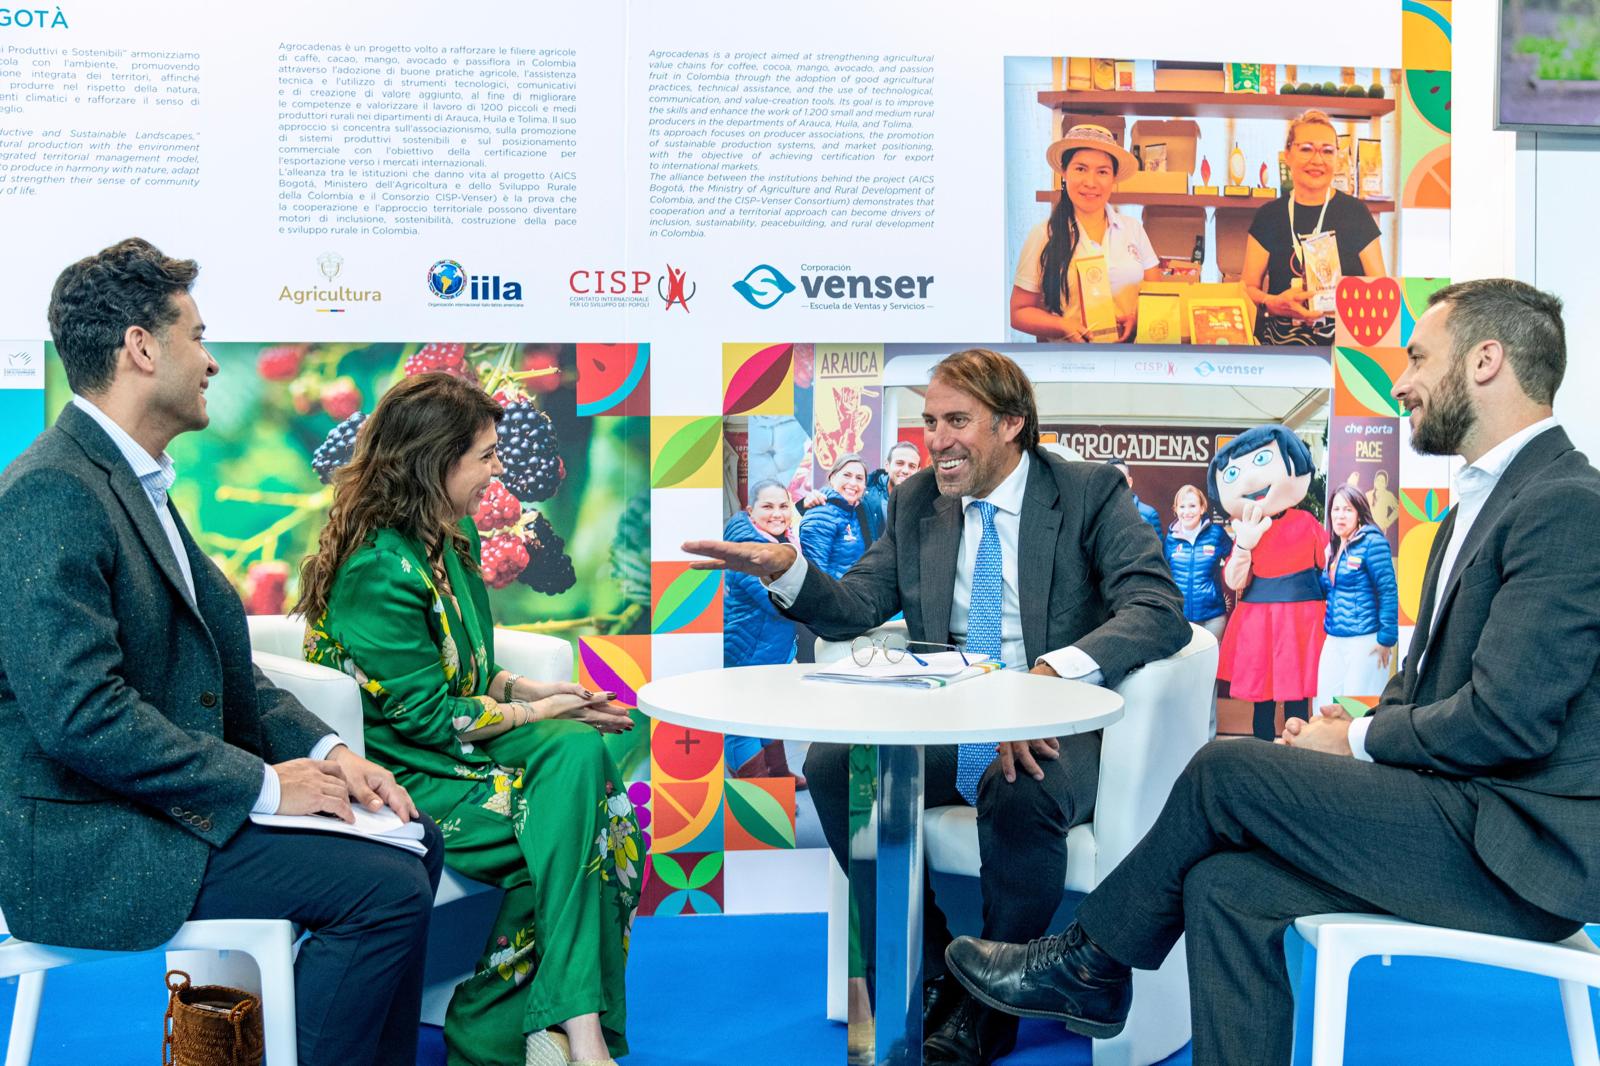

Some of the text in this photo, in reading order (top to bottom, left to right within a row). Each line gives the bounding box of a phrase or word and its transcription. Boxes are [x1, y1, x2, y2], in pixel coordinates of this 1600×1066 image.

[279, 42, 341, 51] Agrocadenas
[345, 44, 350, 52] è
[370, 45, 411, 55] progetto
[415, 45, 438, 53] volto
[451, 46, 495, 54] rafforzare
[500, 47, 507, 55] le
[511, 47, 536, 55] filiere
[539, 48, 576, 57] agricole
[407, 56, 446, 65] avocado
[466, 58, 510, 66] passiflora
[532, 58, 576, 67] Colombia
[649, 50, 709, 61] Agrocadenas
[735, 52, 766, 62] project
[771, 52, 799, 60] aimed
[817, 53, 879, 63] strengthening
[884, 55, 934, 64] agricultural
[132, 63, 200, 71] promuovendo
[10, 82, 54, 90] produrre
[64, 82, 78, 91] nel
[88, 84, 125, 92] rispetto
[135, 84, 157, 93] della
[649, 83, 692, 92] practices,
[698, 84, 739, 92] technical
[743, 84, 791, 93] assistance,
[819, 86, 833, 94] the
[858, 86, 867, 94] of
[872, 86, 933, 96] technological,
[26, 93, 67, 102] climatici
[88, 95, 136, 104] rafforzare
[649, 95, 721, 105] communication,
[725, 96, 742, 104] and
[745, 95, 809, 105] value-creation
[853, 98, 873, 107] goal
[898, 98, 934, 107] improve
[367, 101, 418, 110] valorizzare
[434, 102, 462, 110] lavoro
[481, 103, 503, 111] 1200
[508, 104, 538, 112] piccoli
[279, 124, 326, 132] approccio
[496, 126, 516, 134] sulla
[650, 128, 660, 136] Its
[664, 128, 707, 138] approach
[709, 129, 745, 137] focuses
[764, 130, 806, 138] producer
[809, 131, 864, 139] associations,
[887, 132, 934, 140] promotion
[28, 141, 83, 149] production
[139, 143, 199, 151] environment
[387, 146, 433, 155] l'obiettivo
[448, 148, 470, 156] della
[485, 148, 547, 157] certificazione
[96, 155, 160, 163] management
[650, 151, 668, 159] with
[702, 151, 743, 162] objective
[770, 152, 812, 161] achieving
[11, 163, 52, 172] produce
[66, 164, 109, 175] harmony
[172, 166, 199, 175] adapt
[12, 175, 65, 184] strengthen
[71, 176, 92, 184] their
[130, 177, 141, 185] of
[145, 179, 200, 187] community
[325, 180, 367, 188] Ministero
[376, 180, 447, 190] dell'Agricoltura
[469, 182, 491, 190] dello
[499, 182, 540, 192] Sviluppo
[548, 183, 576, 191] Rurale
[288, 225, 328, 235] sviluppo
[331, 226, 358, 234] rurale
[362, 226, 369, 234] in
[372, 226, 419, 235] Colombia.
[661, 230, 706, 238] Colombia.
[801, 263, 851, 272] Corporación
[570, 270, 651, 294] CISP
[801, 276, 934, 299] venser
[471, 276, 522, 300] iila
[279, 286, 382, 305] Agricultura
[821, 352, 878, 374] ARAUCA
[1134, 362, 1163, 371] CISP
[1217, 364, 1264, 375] venser
[1345, 423, 1393, 436] che porta
[1355, 441, 1383, 458] PACE
